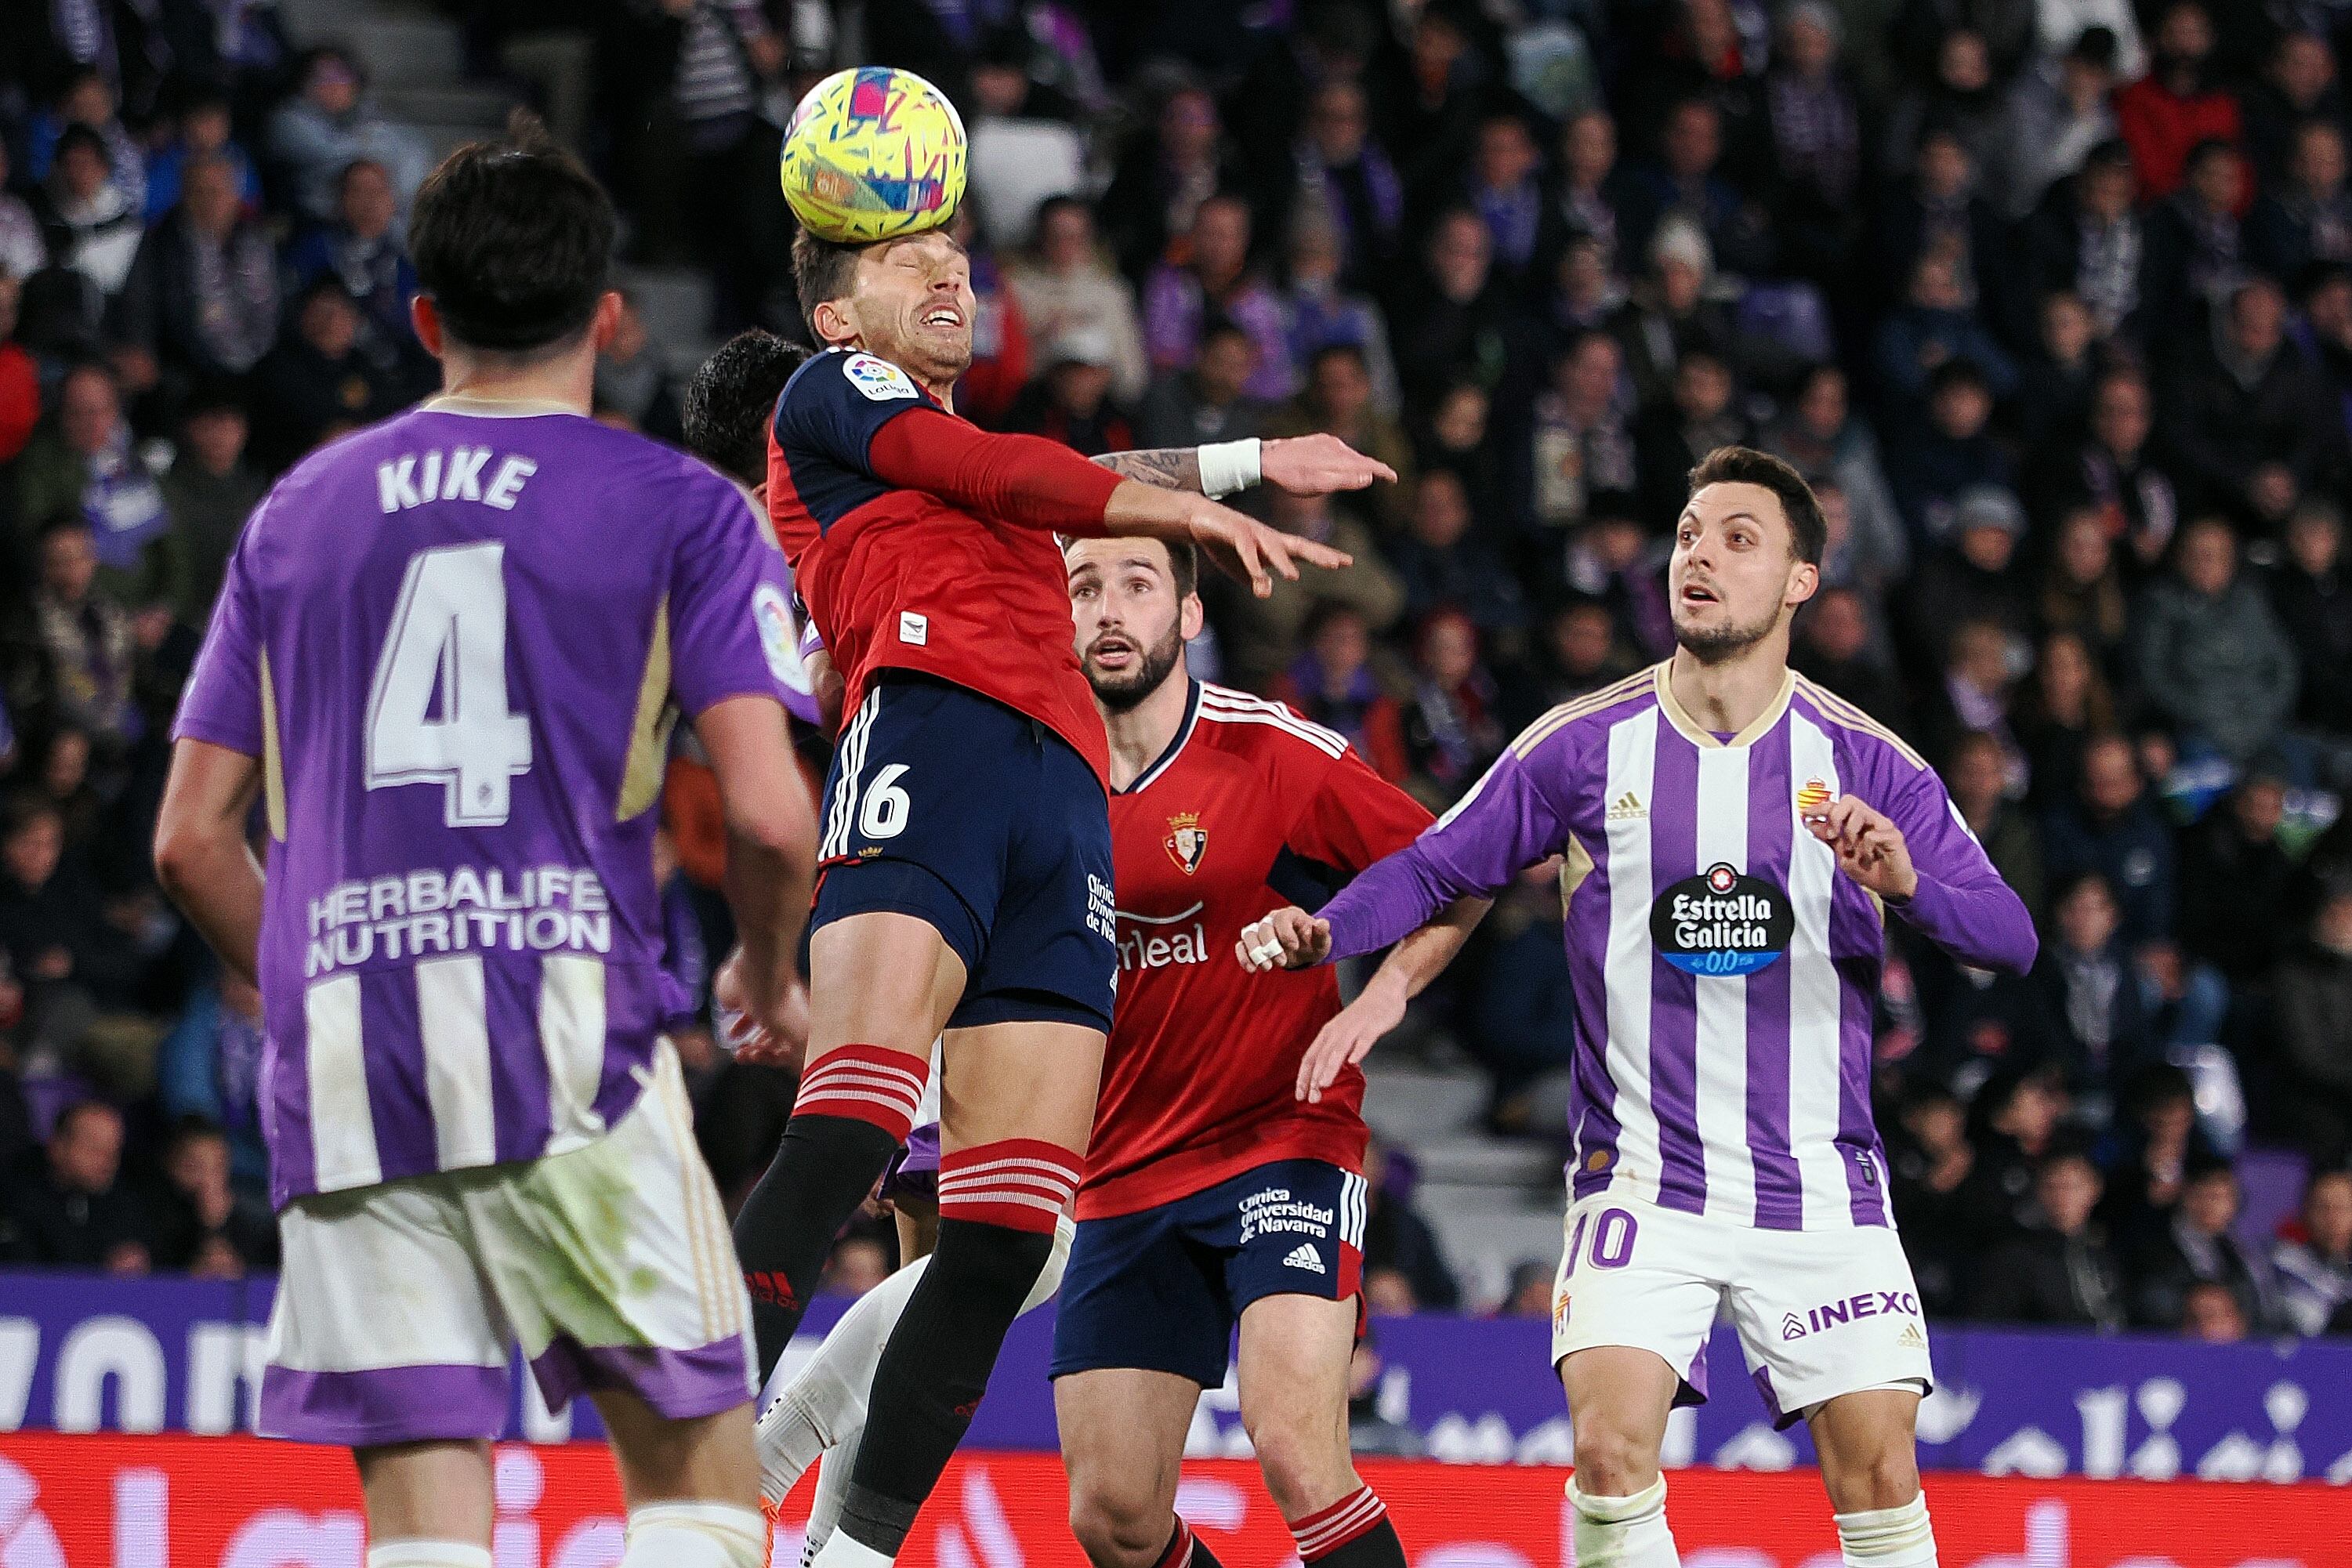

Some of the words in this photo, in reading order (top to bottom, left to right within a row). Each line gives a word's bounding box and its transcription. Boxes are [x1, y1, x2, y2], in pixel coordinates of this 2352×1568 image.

[379, 447, 538, 514] KIKE
[365, 542, 533, 827] 4
[859, 764, 911, 839] 6
[310, 865, 609, 937] HERBALIFE
[1086, 912, 1100, 932] de
[1671, 893, 1773, 921] Estrella
[306, 910, 611, 977] NUTRITION
[1117, 922, 1209, 971] rleal
[1674, 921, 1768, 949] Galicia
[1258, 1216, 1326, 1239] Navarra
[1564, 1208, 1639, 1283] 10
[1283, 1257, 1326, 1275] adidas
[1808, 1291, 1918, 1333] INEXO
